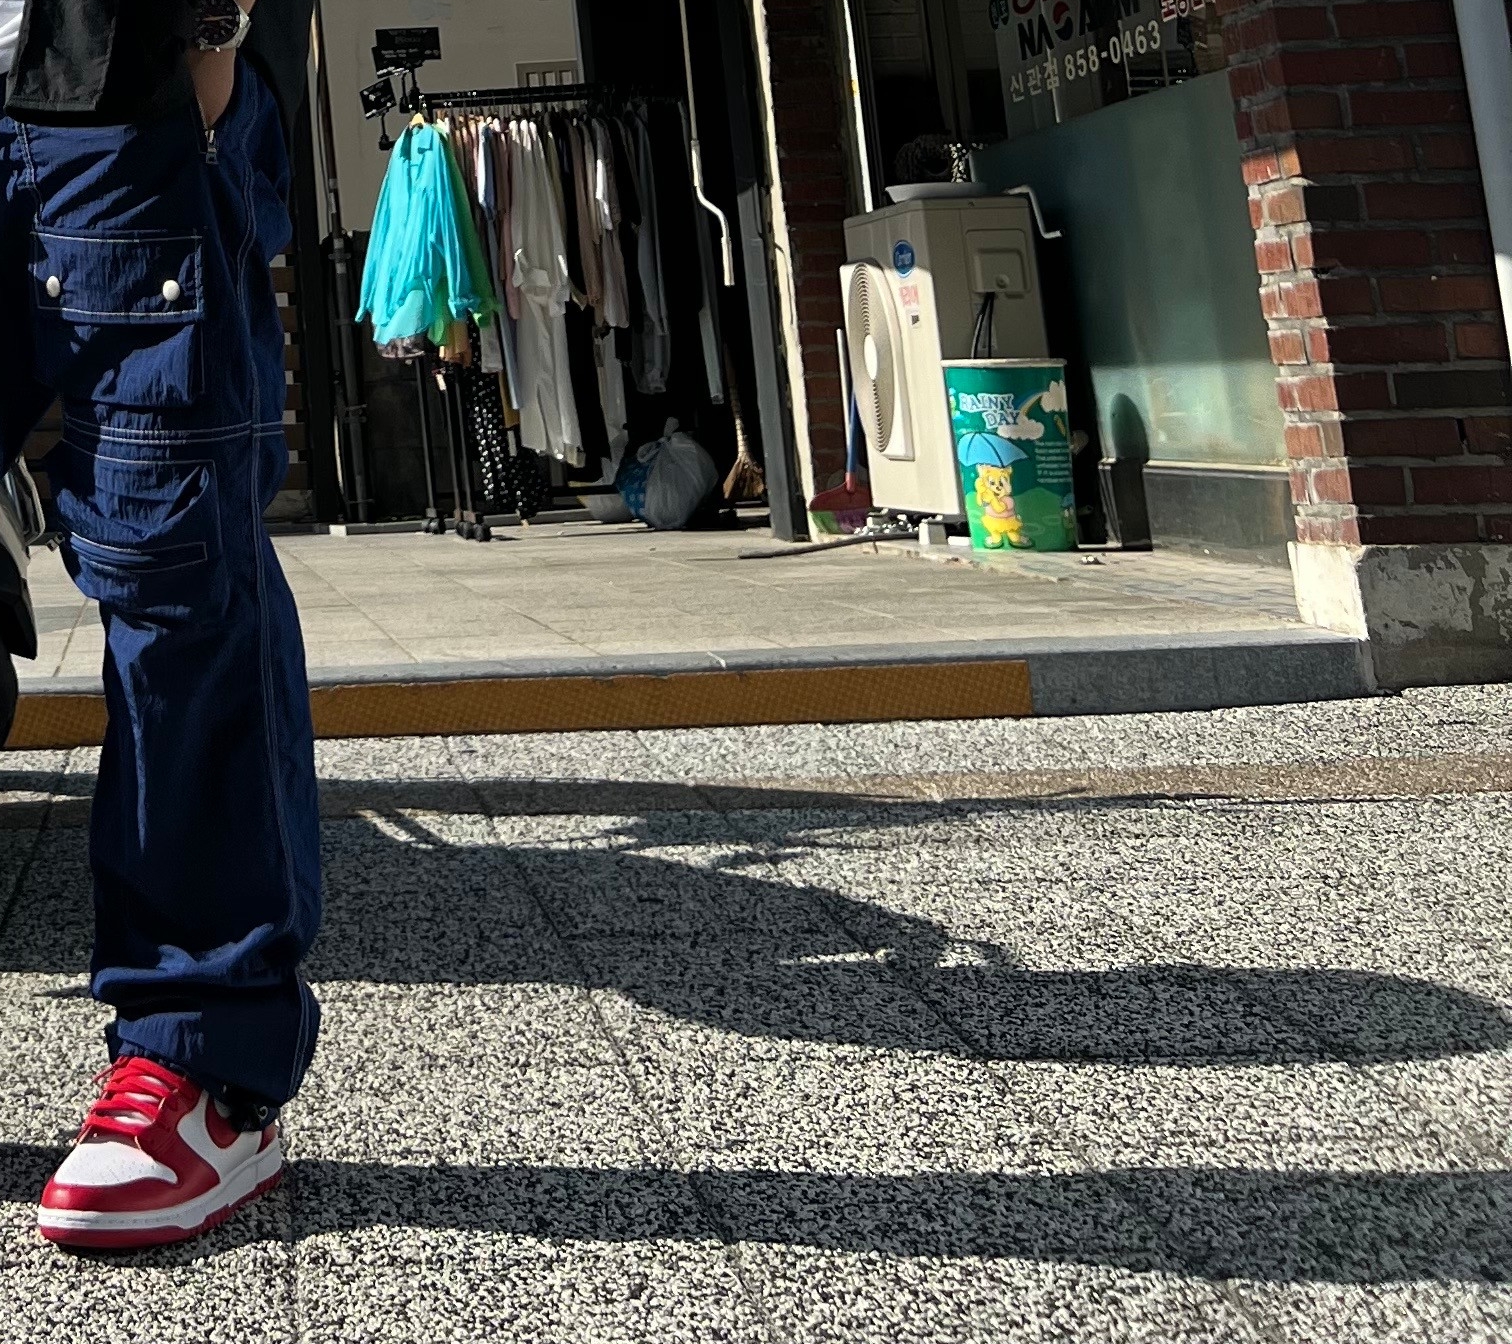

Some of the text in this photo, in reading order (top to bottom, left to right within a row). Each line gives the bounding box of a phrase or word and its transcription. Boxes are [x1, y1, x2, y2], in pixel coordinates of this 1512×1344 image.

[1064, 20, 1161, 80] 858-0463
[959, 394, 1014, 412] RAINY
[984, 410, 1020, 428] DAY
